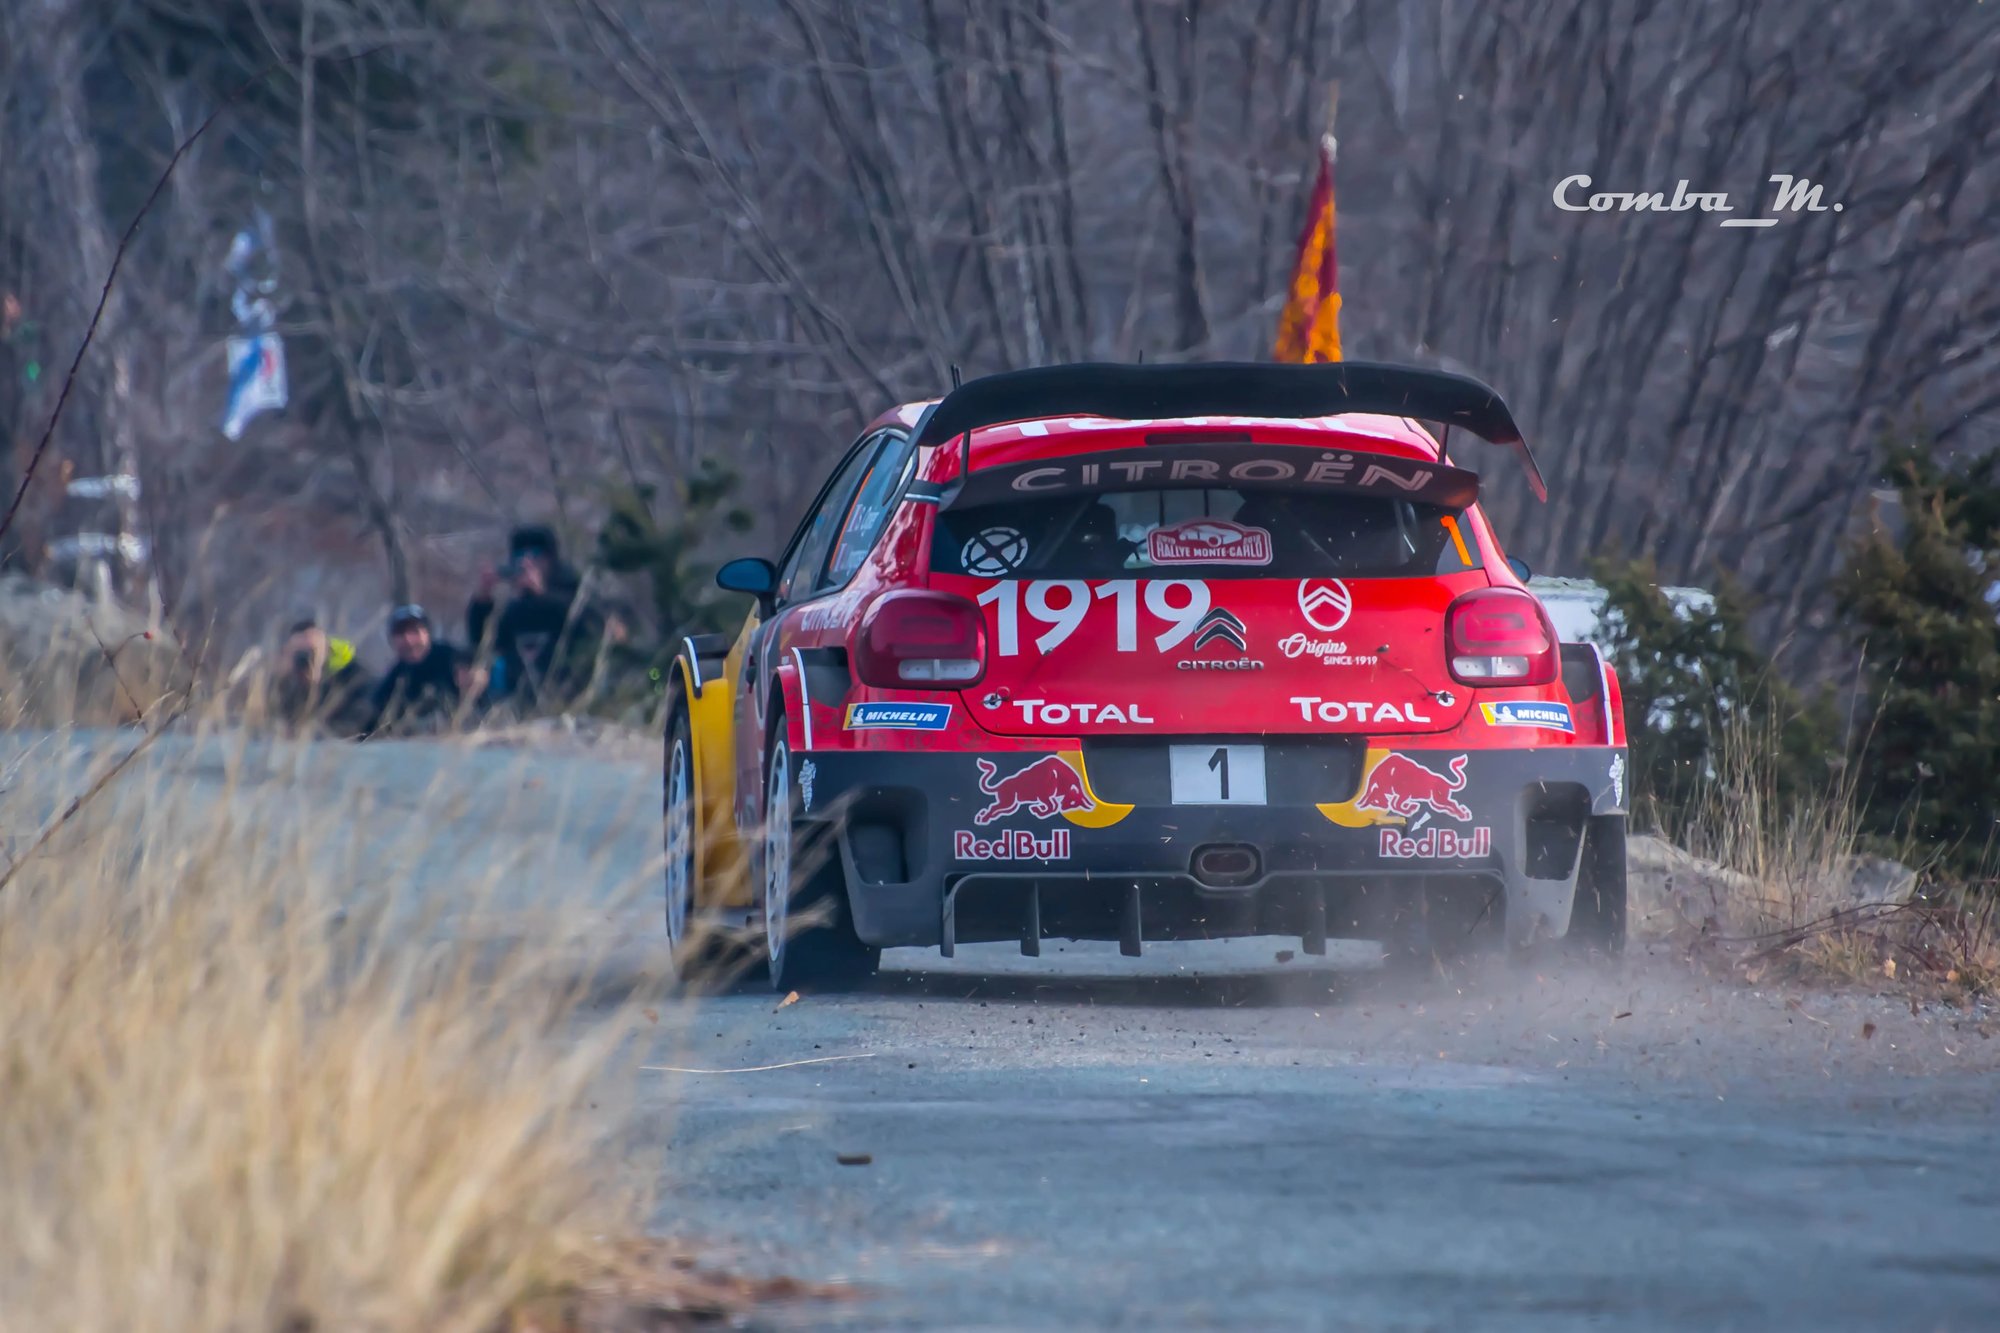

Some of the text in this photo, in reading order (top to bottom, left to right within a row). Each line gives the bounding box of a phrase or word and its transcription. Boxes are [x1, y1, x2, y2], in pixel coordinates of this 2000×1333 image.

[1011, 452, 1433, 492] CITROËN
[1157, 543, 1190, 558] RALLYE
[1440, 515, 1473, 567] 1
[977, 579, 1211, 656] 1919
[1278, 633, 1347, 658] Origins
[1177, 657, 1265, 670] CITROËN
[1323, 656, 1378, 665] SINCE 1919
[865, 711, 938, 722] MICHELIN
[1012, 700, 1154, 725] TOTAL
[1290, 697, 1431, 723] TOTAL
[1208, 747, 1230, 800] 1
